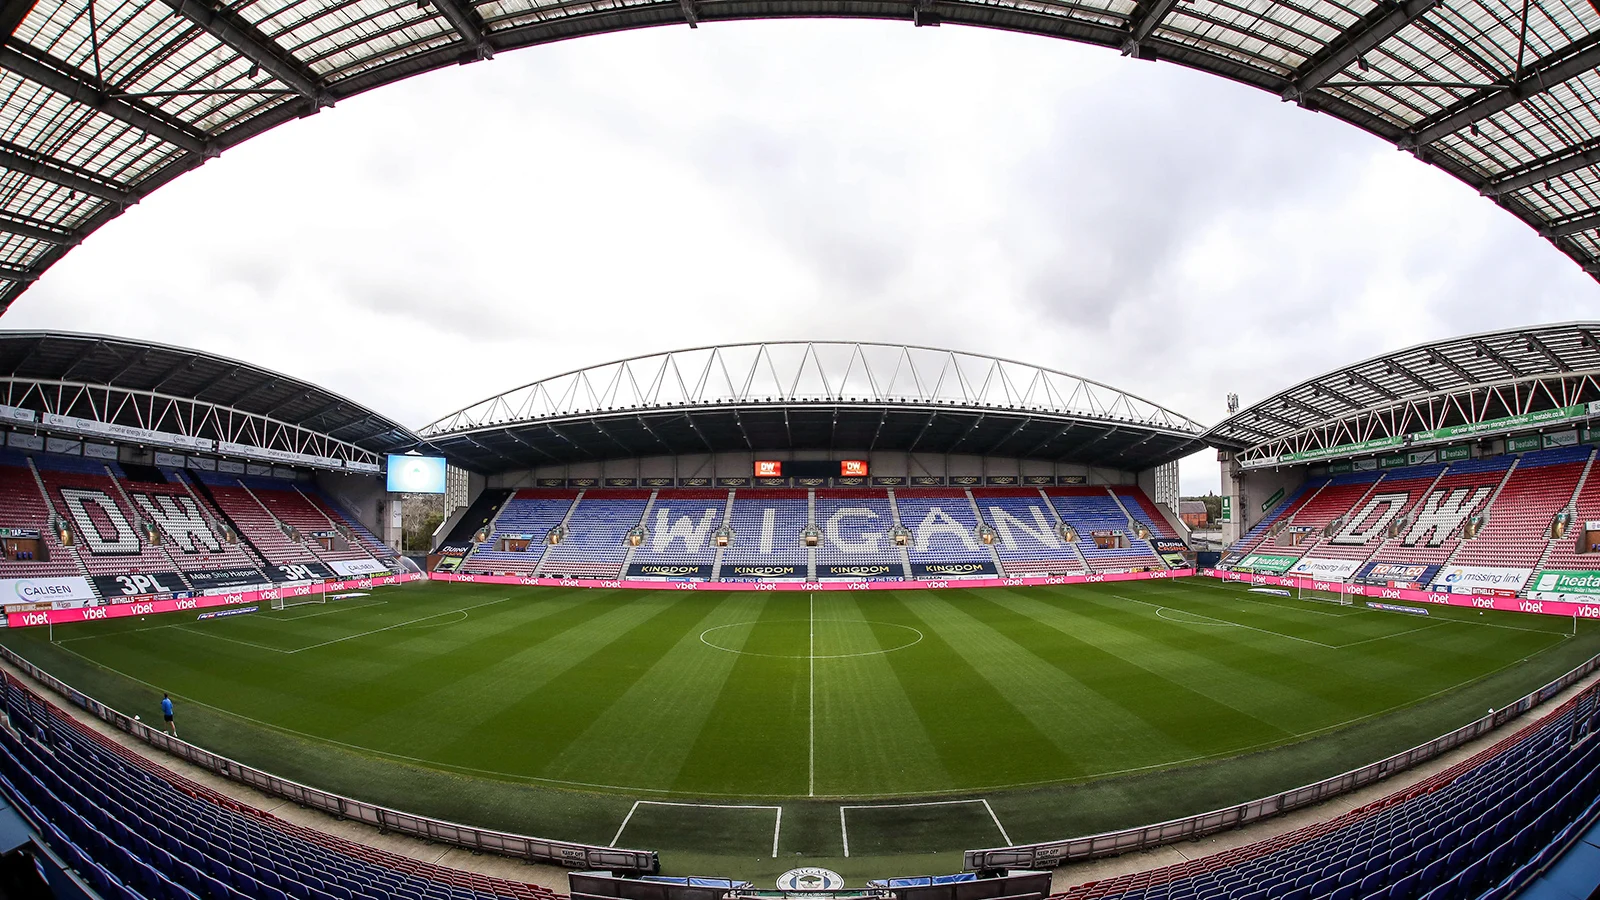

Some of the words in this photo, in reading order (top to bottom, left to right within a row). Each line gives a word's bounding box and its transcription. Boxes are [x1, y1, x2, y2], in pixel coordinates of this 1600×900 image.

[761, 462, 775, 470] DW
[846, 462, 861, 470] DW
[651, 506, 1062, 554] WIGAN
[1255, 557, 1291, 567] heatable
[279, 564, 321, 581] 3PL
[734, 566, 794, 574] KINGDOM
[830, 565, 890, 573] KINGDOM
[925, 564, 983, 572] KINGDOM
[1203, 568, 1215, 577] vbet
[189, 571, 212, 580] Make
[212, 571, 229, 580] Ship
[229, 569, 259, 580] Happen
[409, 573, 421, 581] vbet
[1085, 574, 1105, 582] vbet
[1149, 570, 1167, 578] vbet
[1229, 572, 1241, 580] vbet
[1464, 572, 1503, 585] missing
[1503, 573, 1522, 583] link
[382, 576, 396, 584] vbet
[559, 579, 579, 587] vbet
[600, 580, 622, 588] vbet
[926, 580, 949, 588] vbet
[1002, 578, 1024, 586] vbet
[1044, 577, 1065, 585] vbet
[1279, 577, 1295, 587] vbet
[116, 574, 170, 596] 3PL
[330, 582, 345, 591] vbet
[675, 582, 698, 590] vbet
[753, 582, 777, 591] vbet
[800, 582, 824, 591] vbet
[847, 582, 870, 590] vbet
[1314, 582, 1331, 591] vbet
[23, 585, 72, 596] CALISEN
[293, 586, 311, 596] vbet
[1346, 585, 1364, 595] vbet
[1381, 588, 1401, 599] vbet
[223, 594, 243, 604] vbet
[1428, 593, 1449, 604] vbet
[1472, 597, 1495, 609] vbet
[131, 602, 154, 615] vbet
[175, 599, 197, 610] vbet
[1519, 601, 1544, 613] vbet
[82, 607, 107, 620] vbet
[1577, 604, 1600, 618] vbe
[22, 611, 49, 625] vbet
